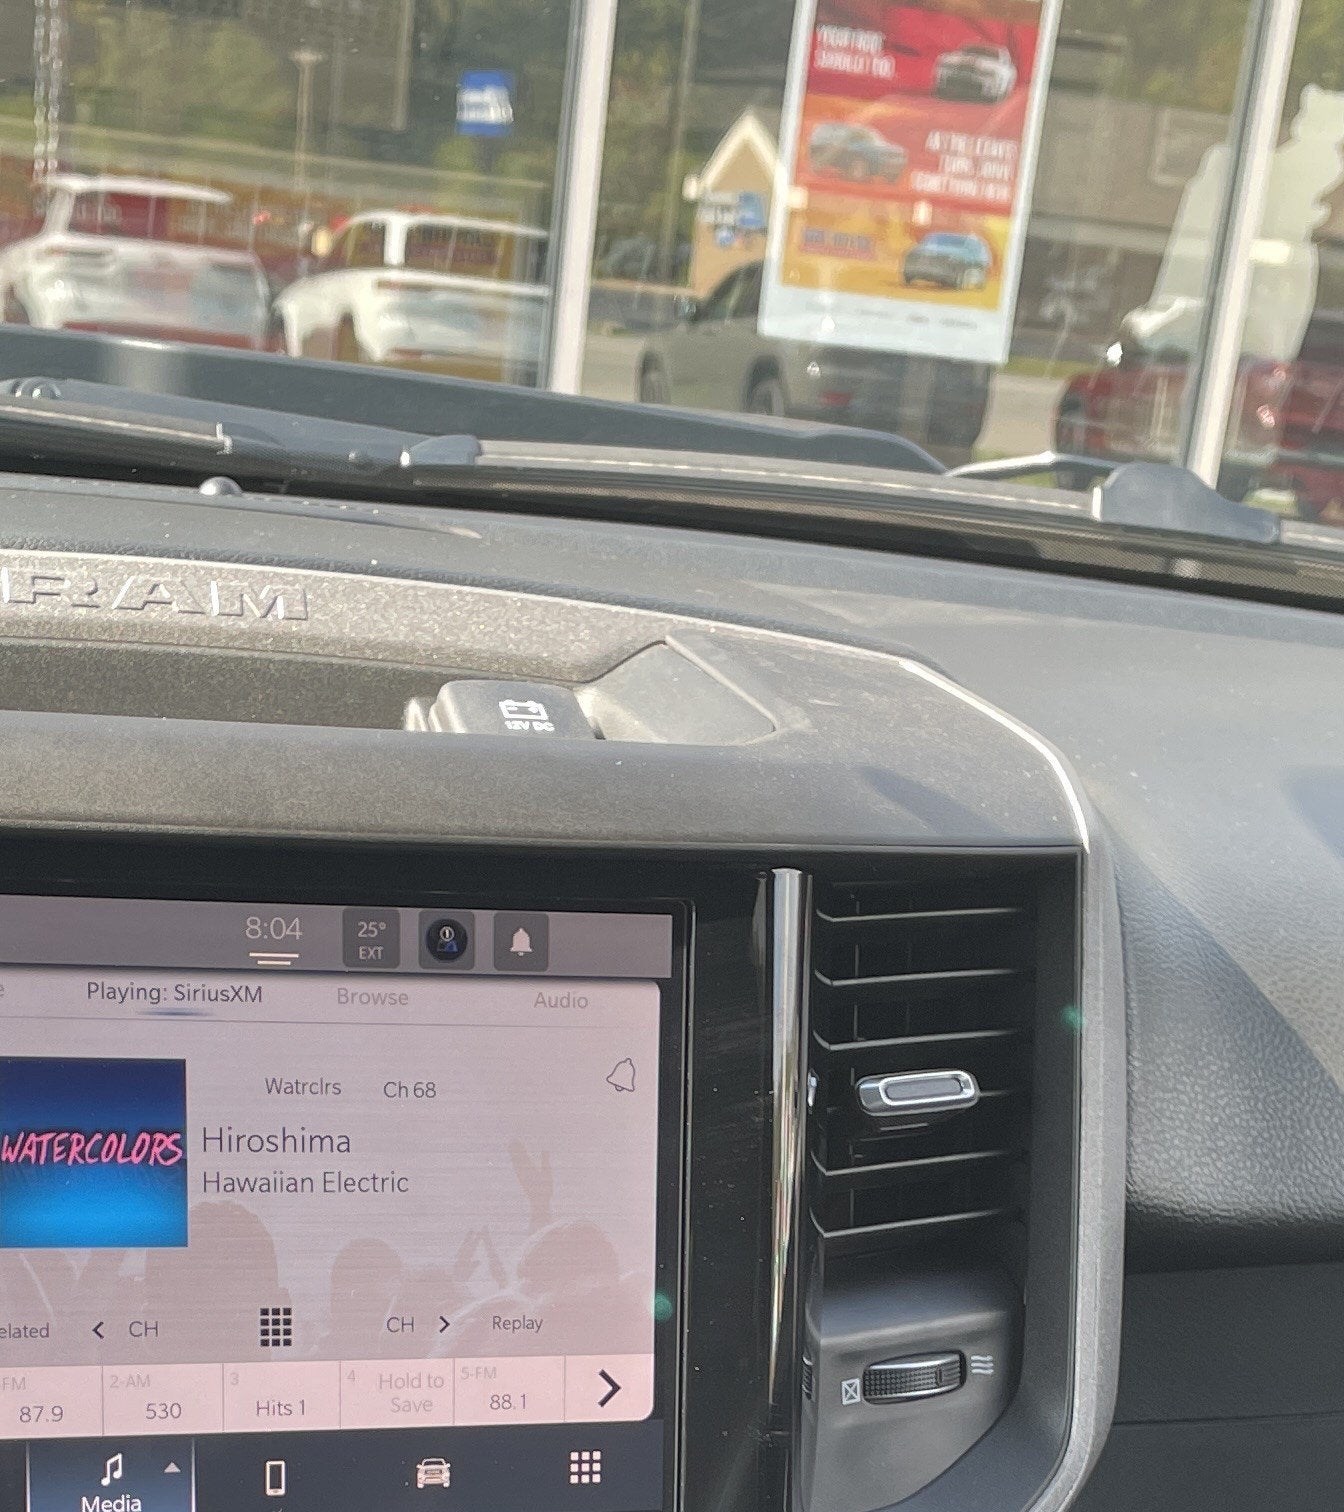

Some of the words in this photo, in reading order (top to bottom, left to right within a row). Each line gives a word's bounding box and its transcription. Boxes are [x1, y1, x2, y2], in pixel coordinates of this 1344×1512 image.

[1, 566, 308, 620] RAM
[504, 720, 530, 730] 12V
[532, 721, 555, 731] DC
[244, 916, 302, 941] 8:04
[358, 921, 387, 938] 25°
[359, 946, 384, 960] EXT
[87, 981, 167, 1004] Playing:
[174, 983, 262, 1003] SiriusXM
[337, 987, 409, 1006] Browse
[534, 991, 588, 1009] Audio
[265, 1077, 342, 1096] Watrclrs
[383, 1080, 409, 1099] Ch
[413, 1081, 437, 1099] 68
[0, 1129, 184, 1166] WATERCOLORS
[202, 1127, 352, 1154] Hiroshima
[202, 1170, 315, 1193] Hawaiian
[323, 1171, 409, 1194] Electric
[128, 1320, 159, 1338] CH
[386, 1316, 415, 1333] CH
[492, 1314, 544, 1333] Replay
[110, 1373, 151, 1388] 2-AM
[230, 1372, 239, 1386] 3
[379, 1372, 422, 1390] Hold
[427, 1373, 444, 1389] to
[460, 1366, 497, 1380] 5-FM
[145, 1401, 182, 1419] 530
[256, 1399, 293, 1416] Hits
[299, 1399, 306, 1415] 1
[390, 1397, 433, 1413] Save
[489, 1394, 527, 1410] 88.1
[19, 1405, 64, 1423] 87.9
